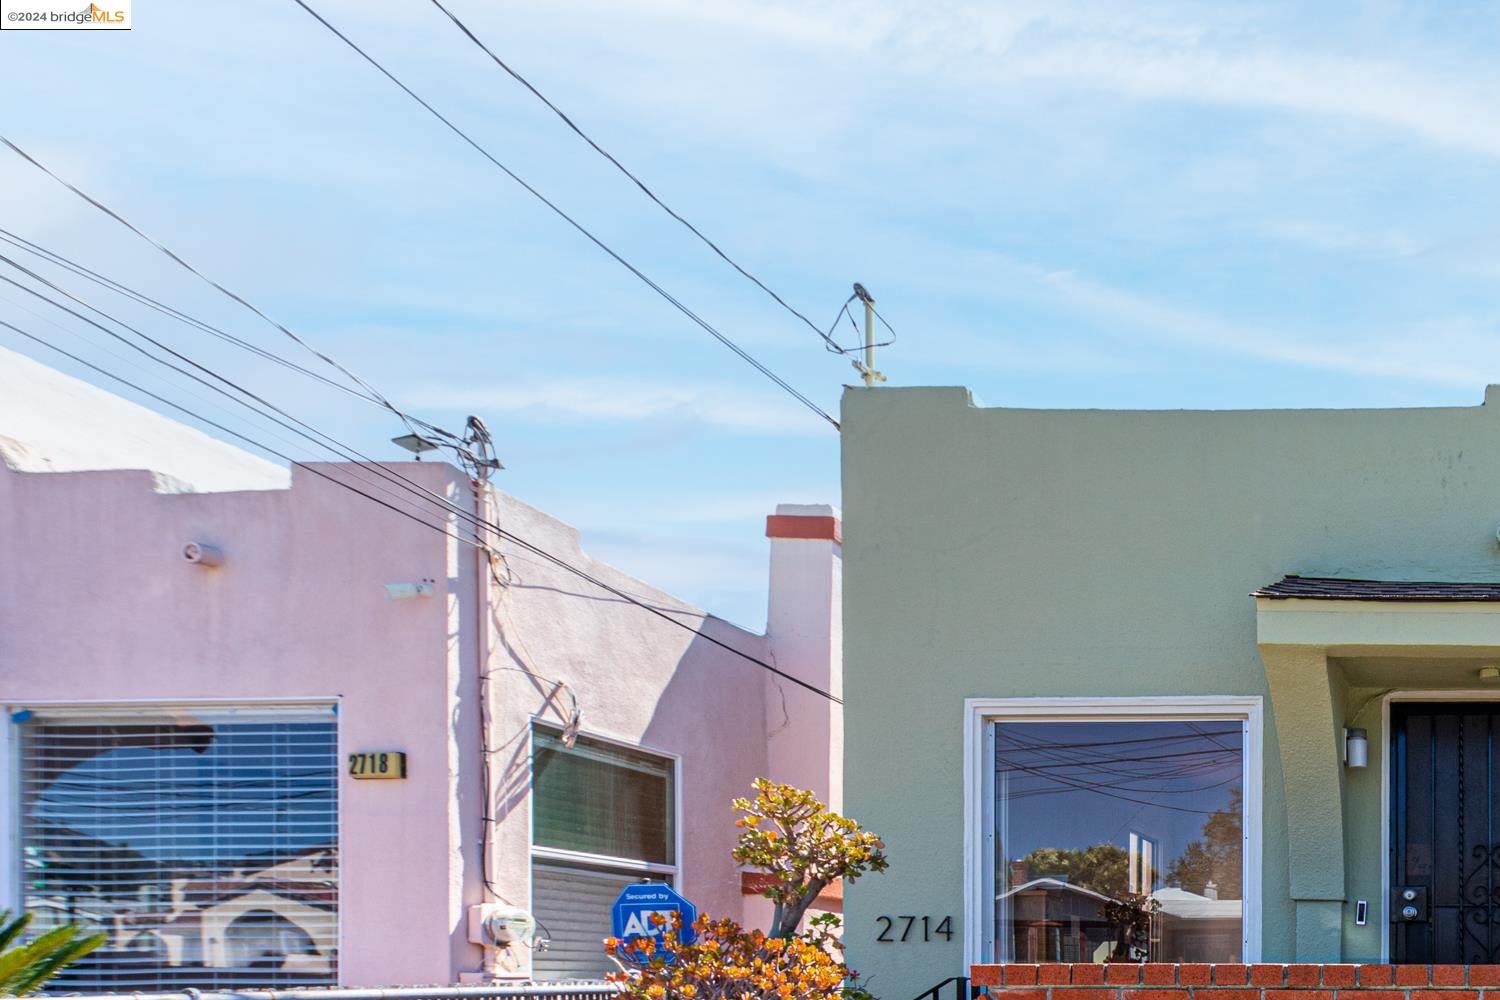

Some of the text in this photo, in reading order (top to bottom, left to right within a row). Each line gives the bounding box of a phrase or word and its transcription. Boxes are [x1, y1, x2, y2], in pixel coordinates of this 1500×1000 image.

[349, 753, 388, 775] 2718
[658, 893, 669, 901] by
[876, 915, 955, 942] 2714
